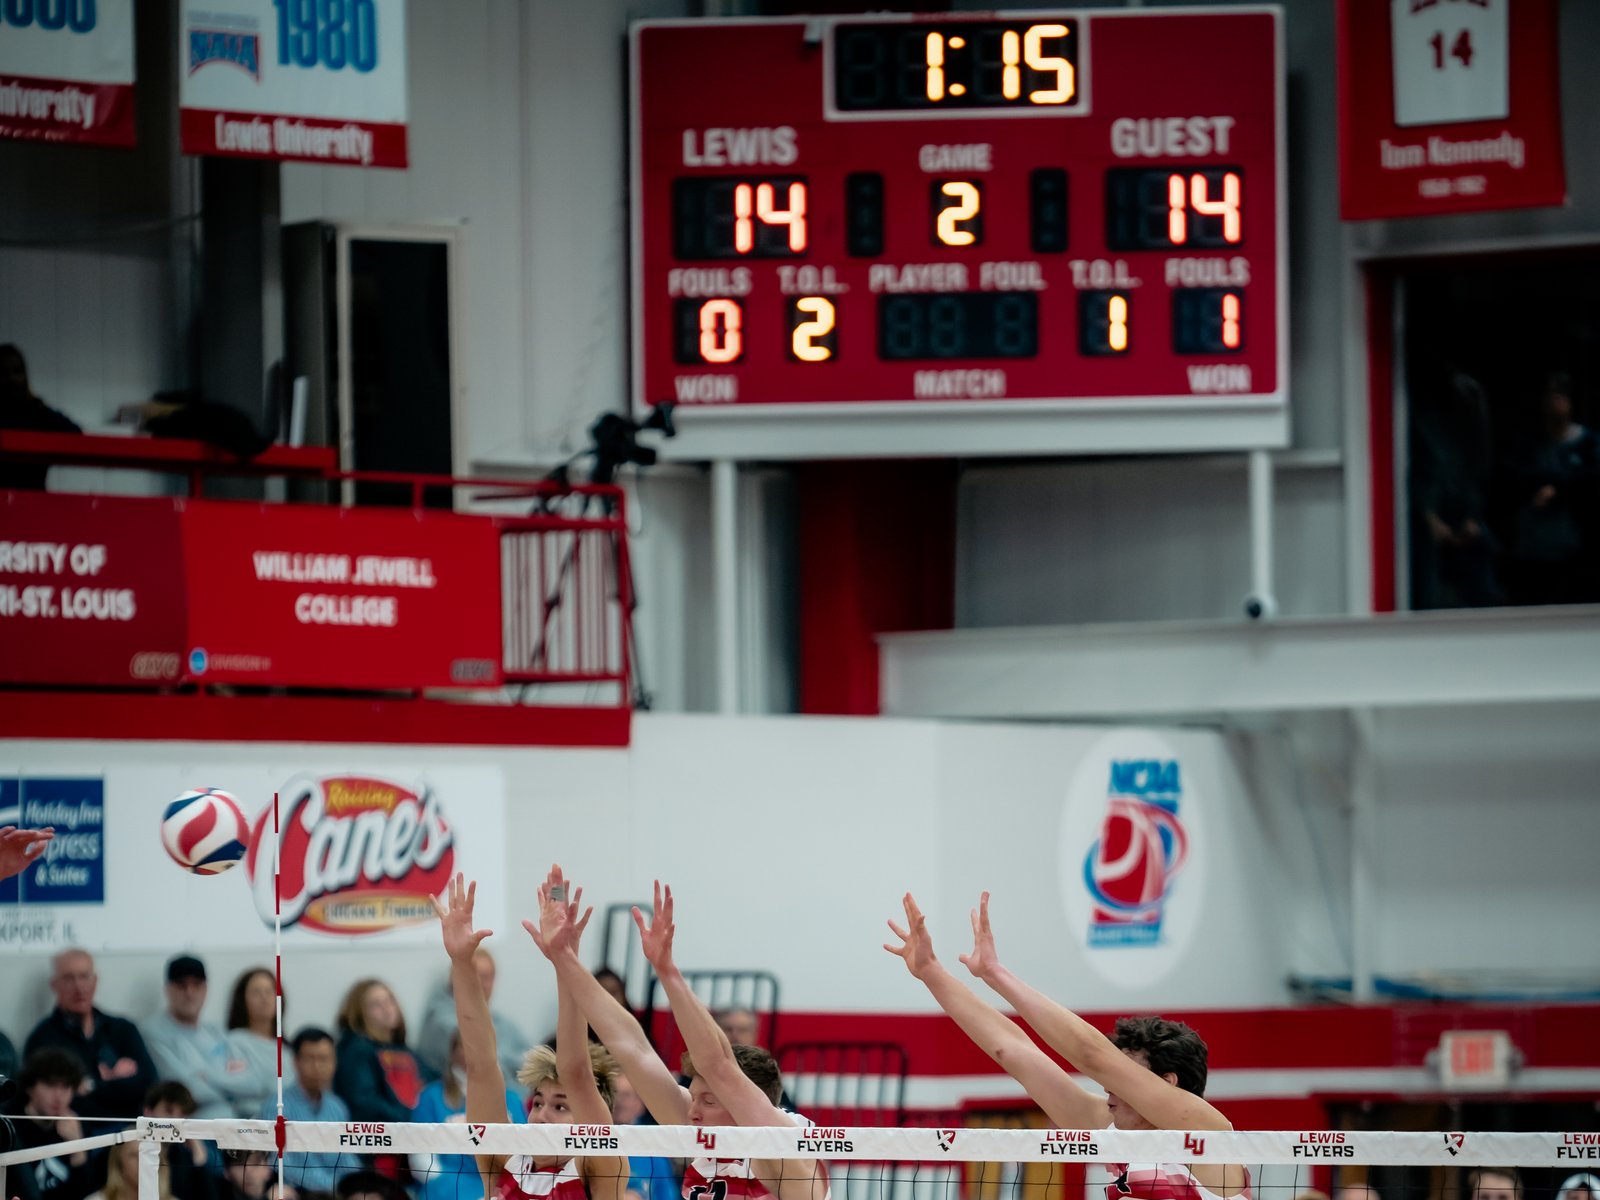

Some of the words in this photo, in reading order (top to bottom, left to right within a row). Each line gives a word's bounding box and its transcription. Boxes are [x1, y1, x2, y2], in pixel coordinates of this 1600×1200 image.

[926, 24, 1074, 104] 1:15
[1427, 28, 1475, 70] 14
[683, 125, 798, 167] LEWIS
[1110, 116, 1236, 158] GUEST
[918, 143, 993, 172] GAME
[735, 182, 806, 253] 14
[937, 182, 980, 245] 2
[1168, 173, 1240, 245] 14
[668, 267, 751, 298] FOULS
[869, 263, 968, 292] PLAYER
[979, 261, 1047, 290] FOUL
[1165, 257, 1250, 287] FOULS
[700, 299, 741, 363] 0
[793, 297, 835, 361] 2
[1109, 296, 1128, 350] 1
[1222, 293, 1240, 348] 1
[674, 374, 738, 403] WON
[914, 368, 1006, 399] MATCH
[1186, 364, 1251, 394] WON
[70, 544, 107, 576] OF
[253, 551, 352, 584] WILLIAM
[352, 555, 437, 588] JEWELL
[61, 587, 136, 621] LOUIS
[295, 593, 398, 627] COLLEGE
[328, 782, 395, 813] Raising
[25, 800, 79, 830] Holiday
[79, 799, 102, 825] Inn
[48, 865, 90, 886] Suites
[340, 1135, 392, 1147] FLYERS
[345, 1124, 385, 1133] LEWIS
[564, 1138, 618, 1149] FLYERS
[570, 1126, 610, 1136] LEWIS
[803, 1128, 845, 1139] LEWIS
[1046, 1131, 1091, 1142] LEWIS
[1299, 1132, 1345, 1143] LEWIS
[798, 1140, 853, 1152] FLYERS
[1040, 1143, 1098, 1155] FLYERS
[1293, 1145, 1354, 1157] FLYERS
